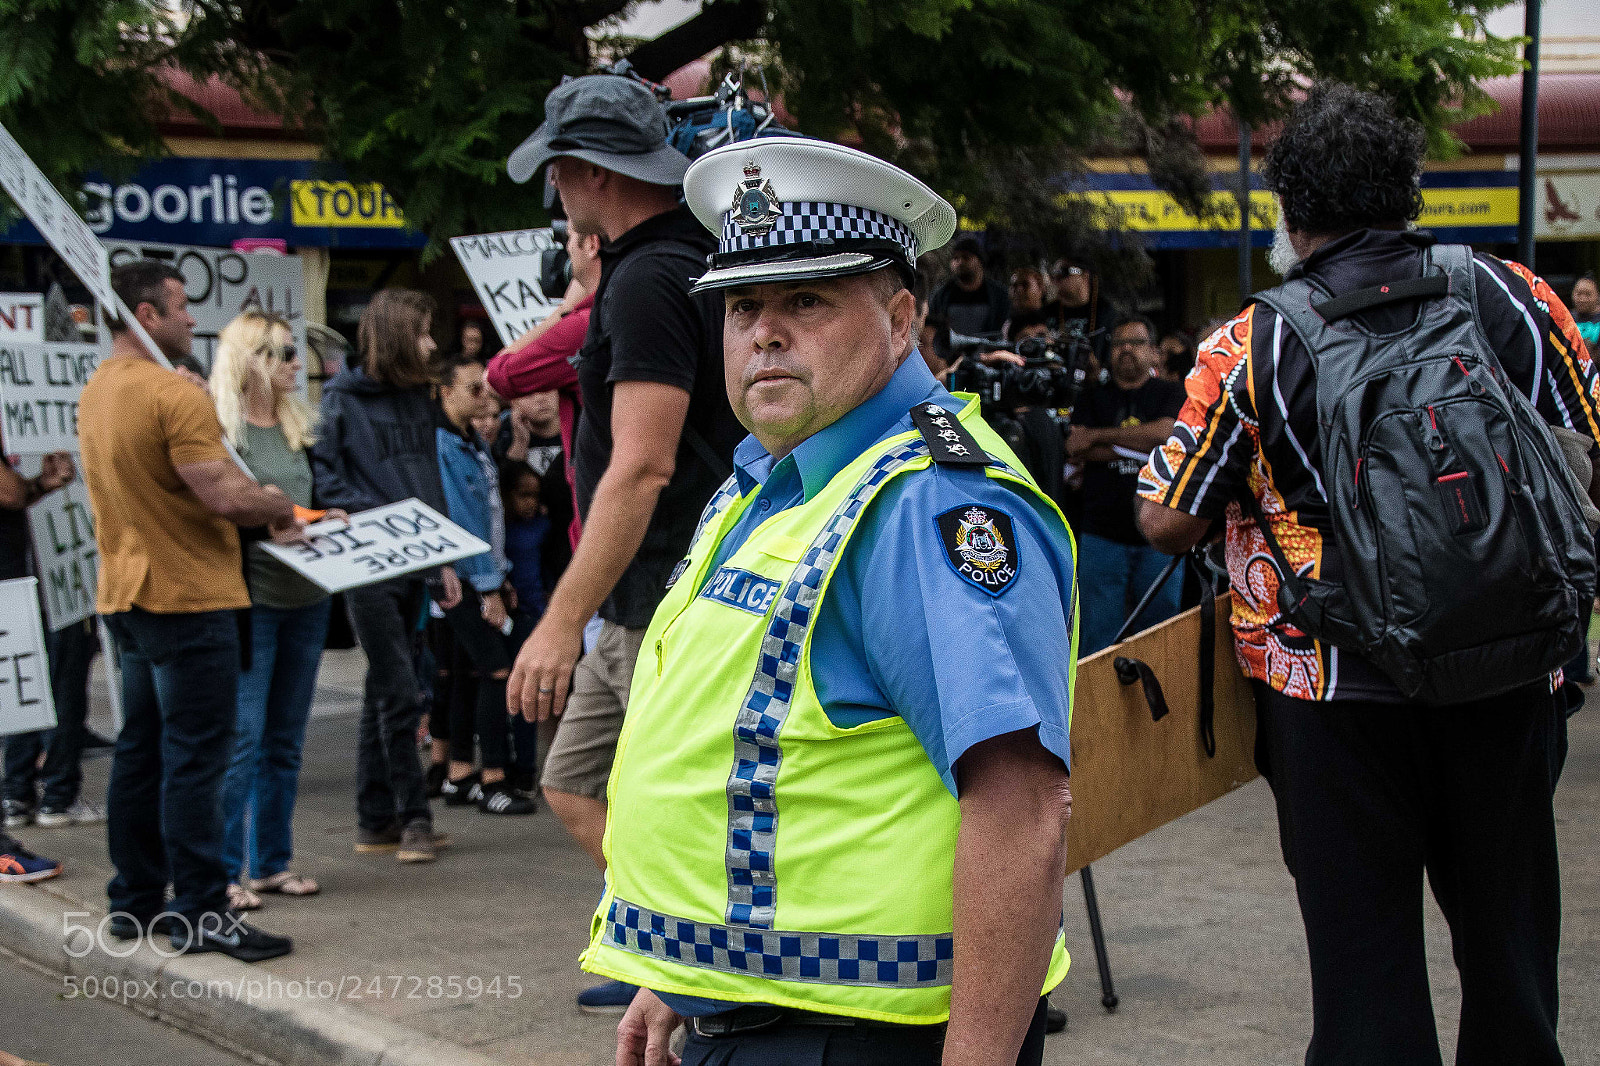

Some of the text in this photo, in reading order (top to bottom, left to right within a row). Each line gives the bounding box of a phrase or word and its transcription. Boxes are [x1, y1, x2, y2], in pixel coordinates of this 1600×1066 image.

[110, 249, 247, 307] OP
[0, 348, 33, 387] ALL
[297, 507, 441, 563] POLICE
[353, 535, 459, 575] MORE
[706, 570, 778, 611] POLICE
[957, 562, 1016, 586] POLICE
